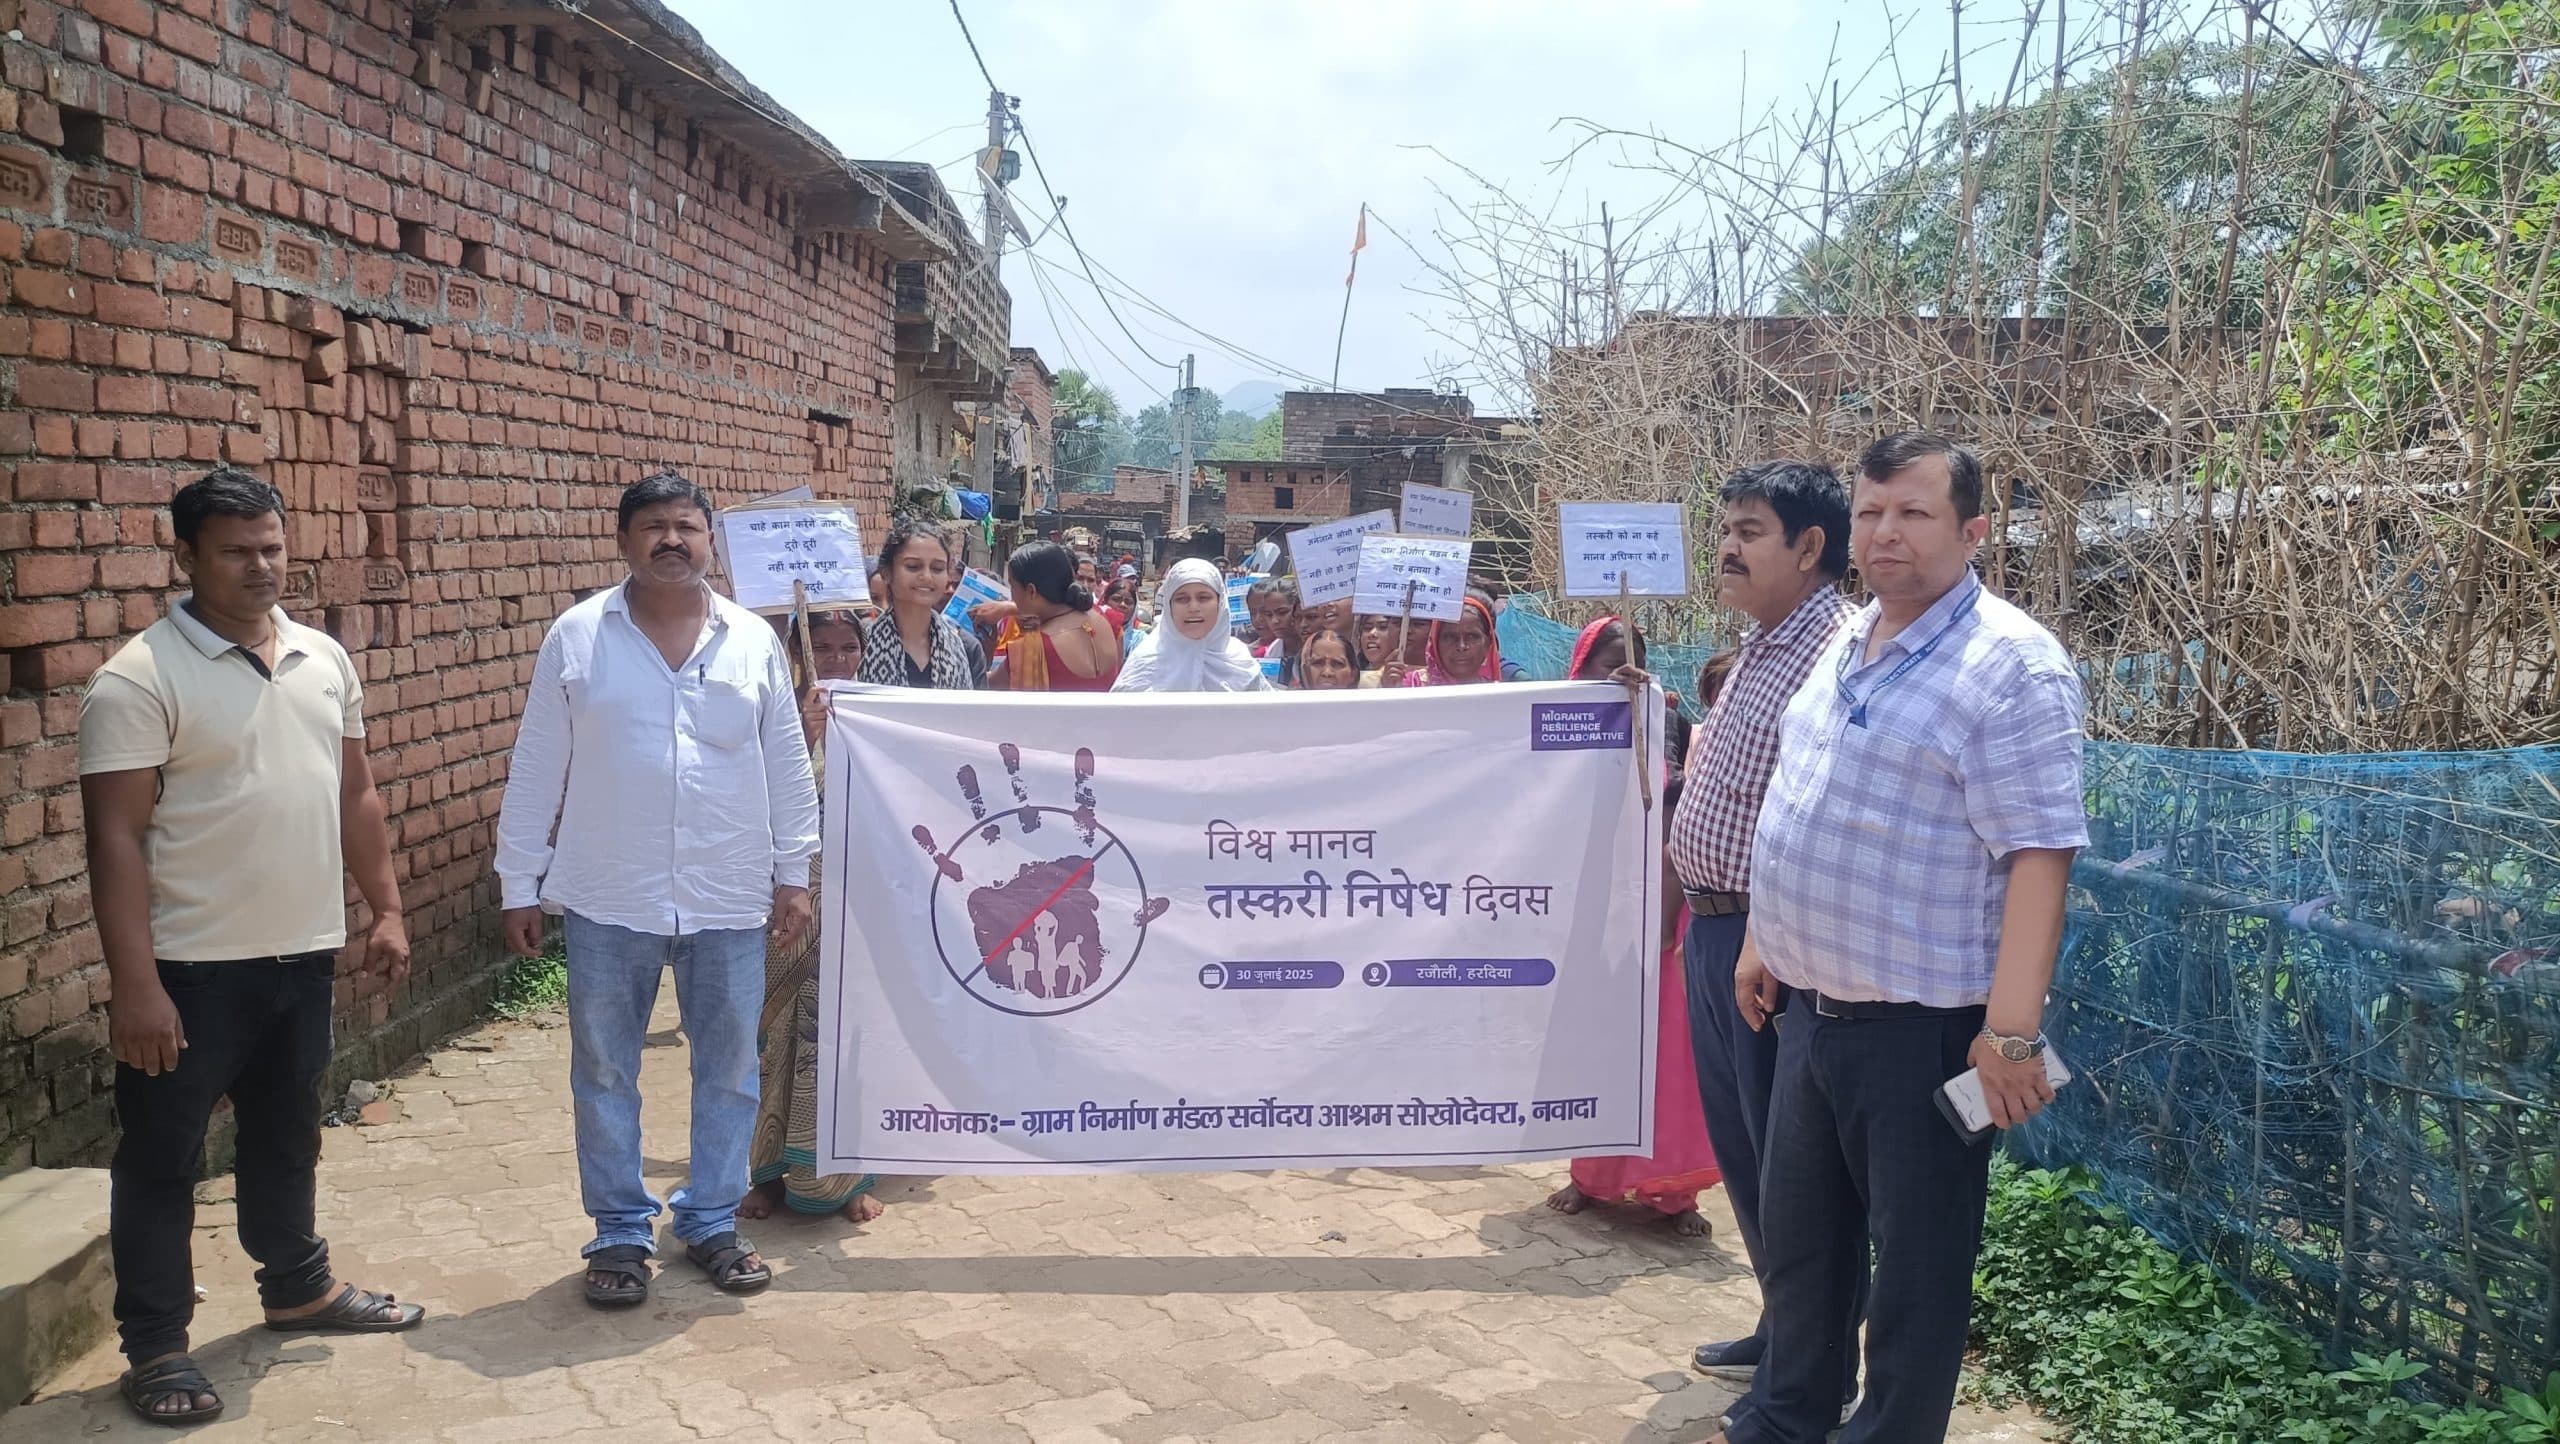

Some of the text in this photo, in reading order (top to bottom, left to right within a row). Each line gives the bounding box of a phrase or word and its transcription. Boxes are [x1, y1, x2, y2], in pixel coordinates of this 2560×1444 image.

[771, 521, 790, 529] काम
[1585, 529, 1613, 541] तस्करी
[1617, 529, 1628, 541] को
[1632, 532, 1641, 540] ना
[784, 538, 817, 552] दूरी दूरी
[1399, 545, 1426, 556] निर्माण
[1583, 553, 1605, 561] मानव
[1610, 551, 1642, 561] अधिकार
[1646, 551, 1657, 561] को
[1408, 565, 1431, 575] बताया
[1435, 564, 1440, 576] है
[803, 580, 824, 594] जदूरी
[1312, 581, 1335, 595] तस्करी
[1376, 582, 1397, 590] मानव
[1401, 582, 1426, 593] तकरी
[1443, 586, 1452, 596] हो
[1431, 602, 1437, 612] है
[1541, 710, 1595, 722] MIGRANTS
[1541, 722, 1601, 732] RESILIENCE
[1541, 731, 1625, 742] COLLABORATIVE
[1205, 819, 1377, 862] विश्व मानव
[1204, 868, 1553, 921] तस्करी निषेध दिवस
[1236, 967, 1314, 984] 30 जुलाई 2025
[1415, 963, 1512, 982] रजौली, हरदिया
[1021, 1108, 1075, 1137] ग्राम
[1079, 1099, 1158, 1132] निर्माण
[1162, 1098, 1223, 1130] मंडल
[1227, 1097, 1313, 1128] सर्वोदय
[1318, 1103, 1393, 1127] आश्रम
[1397, 1097, 1526, 1128] सोखोदेवरा,
[1532, 1096, 1598, 1123] नवादा
